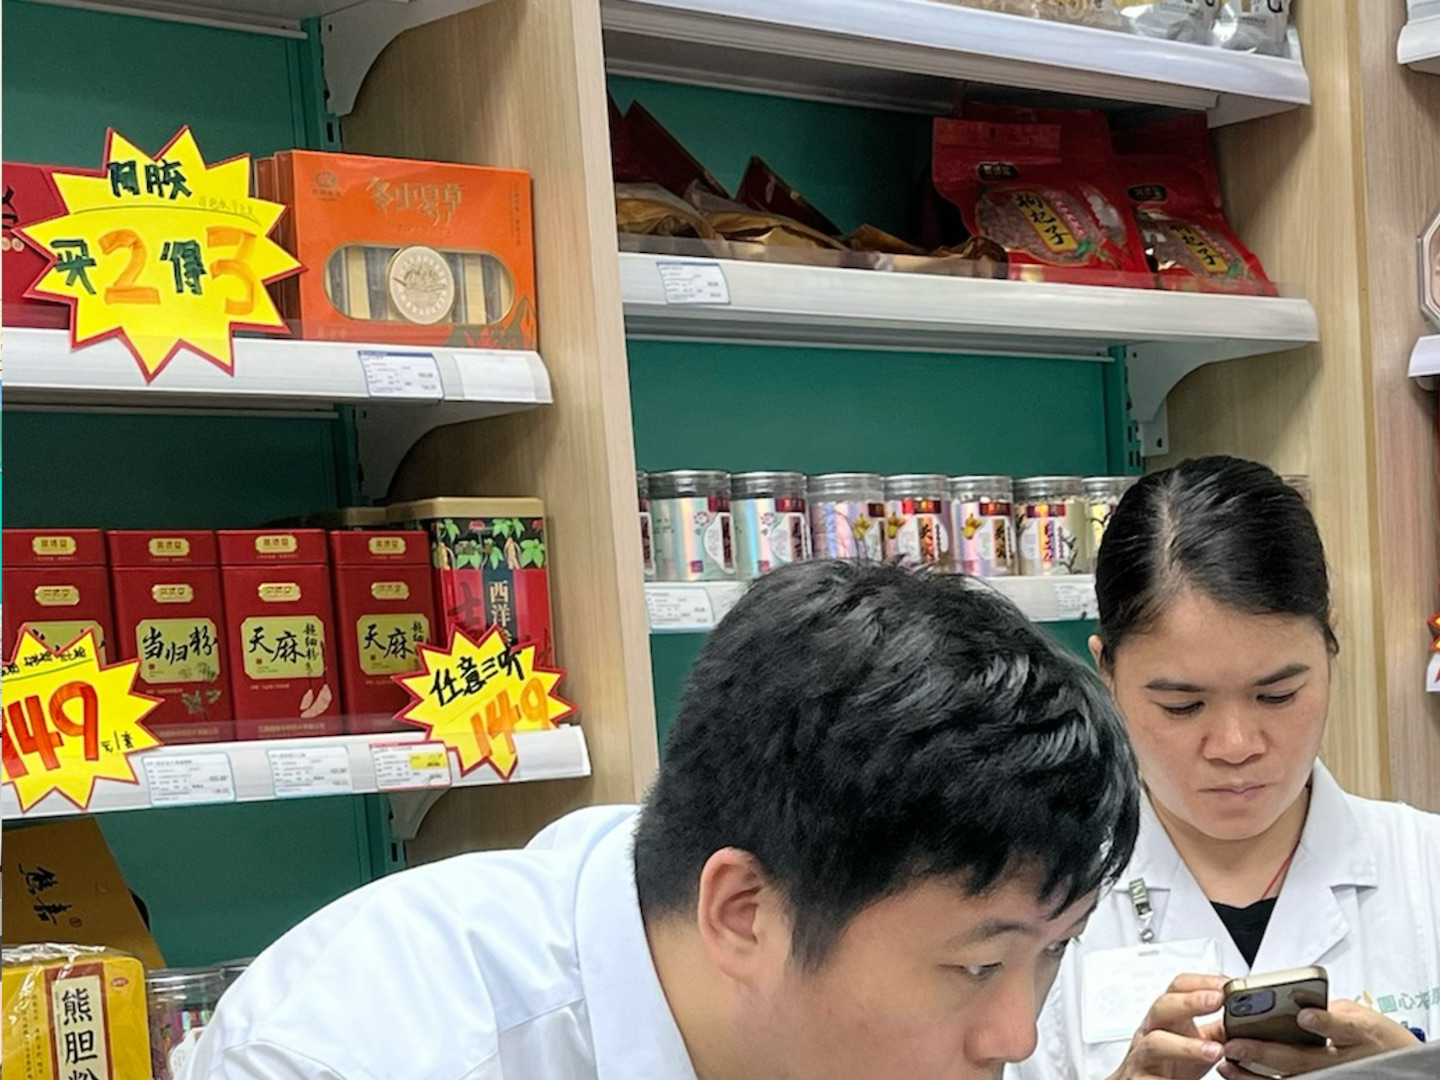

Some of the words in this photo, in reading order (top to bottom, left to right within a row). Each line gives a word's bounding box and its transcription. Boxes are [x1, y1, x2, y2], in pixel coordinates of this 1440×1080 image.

[142, 625, 218, 667] 当归粉
[248, 626, 305, 665] 天麻
[363, 622, 413, 662] 天麻
[470, 677, 552, 757] 149
